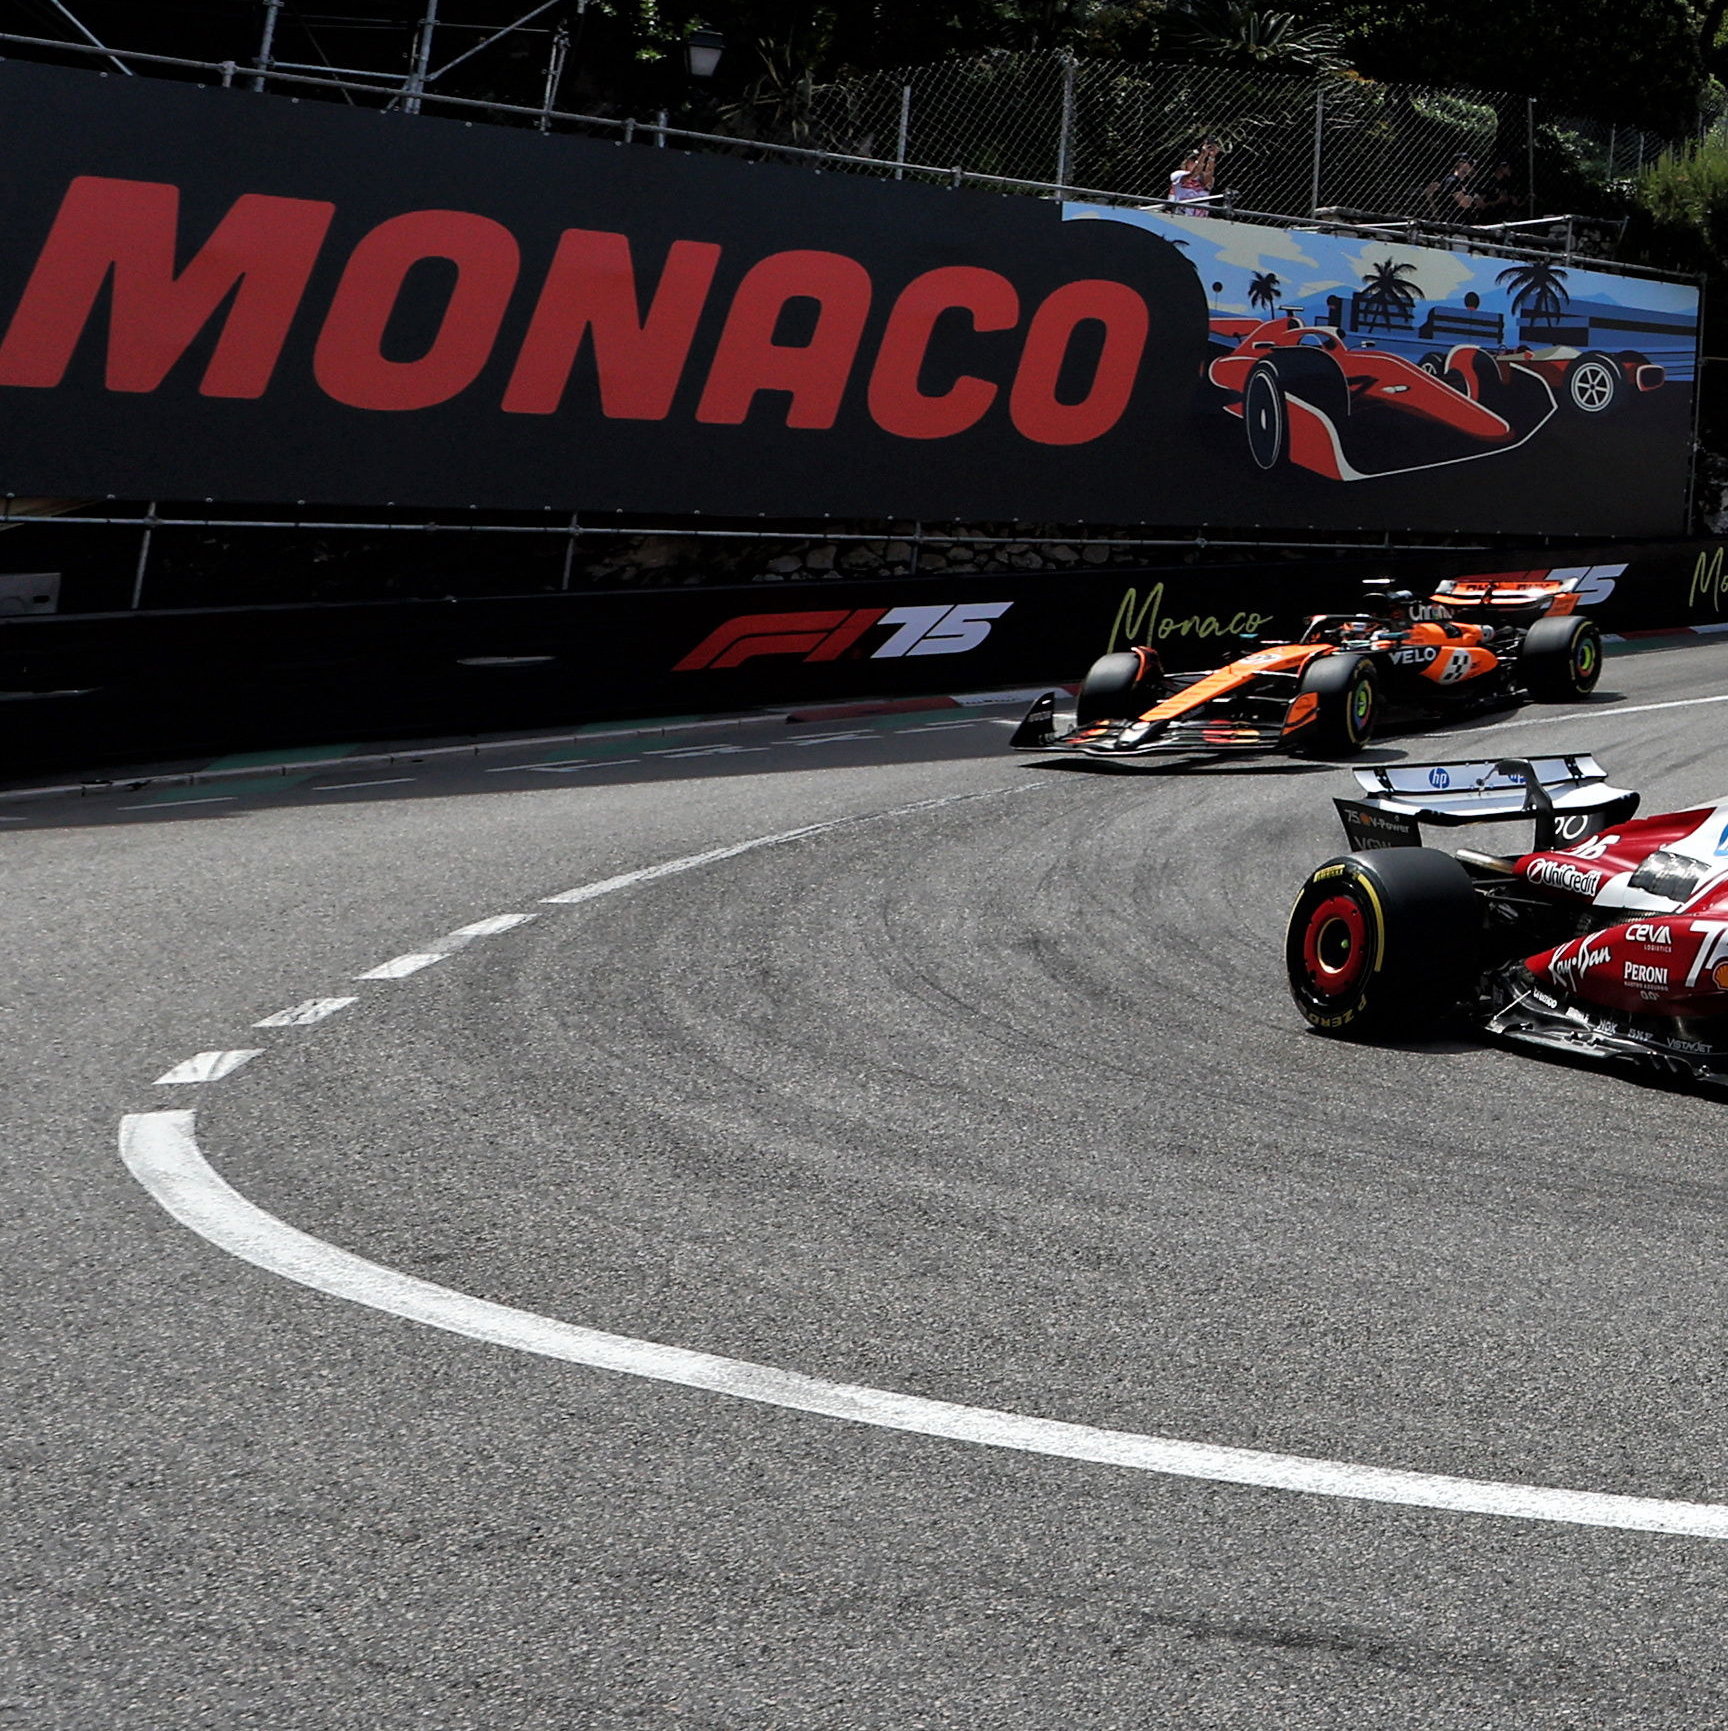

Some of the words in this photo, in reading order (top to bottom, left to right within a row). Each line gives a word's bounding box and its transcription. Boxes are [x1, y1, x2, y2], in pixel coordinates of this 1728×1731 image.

[0, 176, 1149, 446] MONACO
[1107, 581, 1274, 655] Monaco
[670, 607, 890, 672] F1
[870, 601, 1015, 659] 75
[1388, 647, 1437, 665] VELO
[1430, 768, 1449, 789] hp
[1543, 860, 1600, 897] UniCredit
[1624, 961, 1668, 984] PERONI
[1308, 1009, 1355, 1028] ZERO
[1600, 1018, 1618, 1034] NGK
